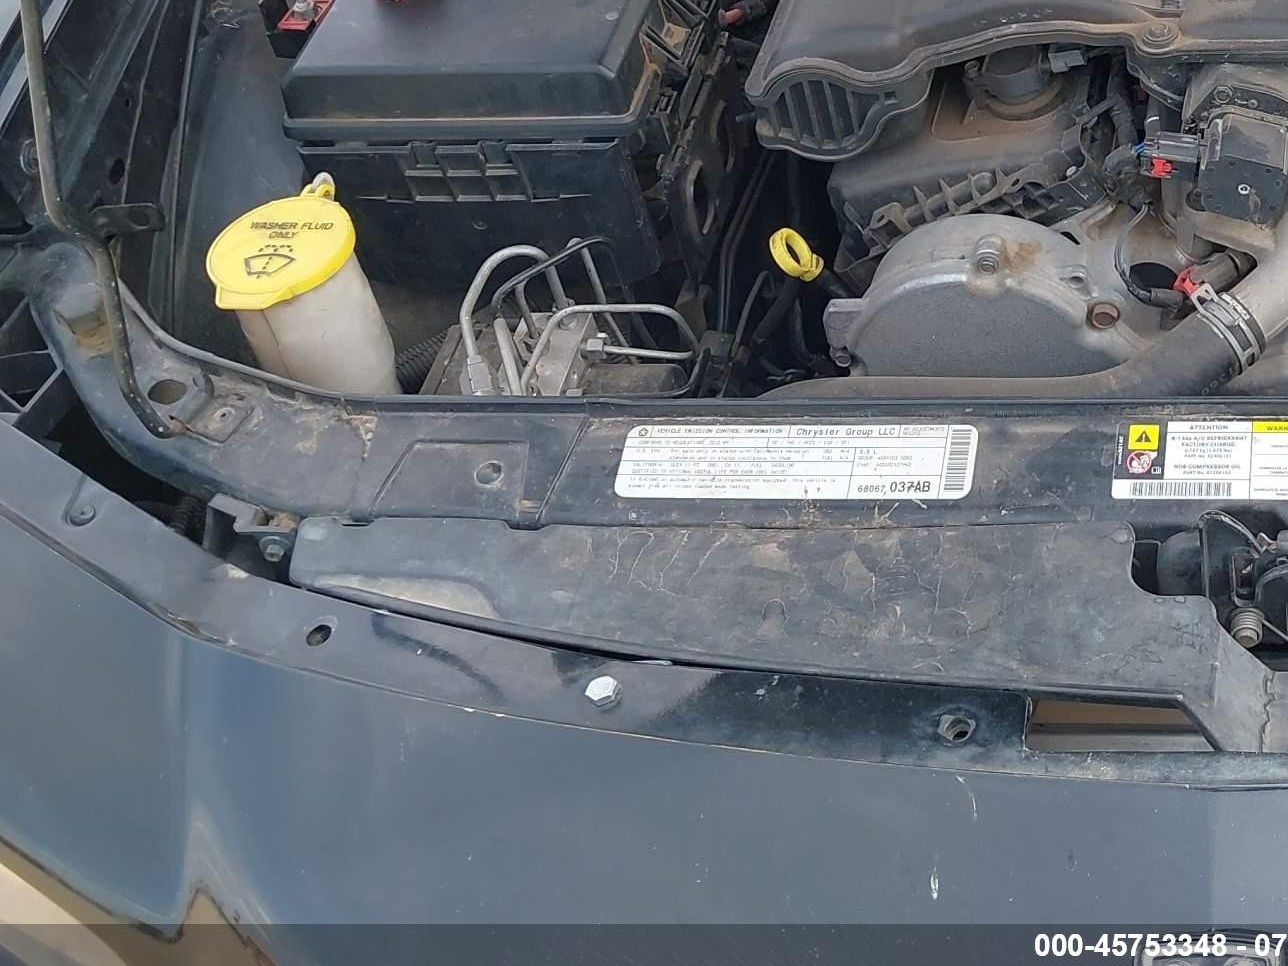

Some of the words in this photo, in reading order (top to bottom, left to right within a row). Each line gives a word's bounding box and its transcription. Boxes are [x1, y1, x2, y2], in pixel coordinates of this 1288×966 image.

[250, 221, 298, 230] WASHER
[300, 221, 334, 230] FLUID
[268, 231, 299, 239] ONLY
[796, 428, 840, 439] Chrysler
[845, 428, 873, 438] Group
[878, 428, 896, 436] LLC
[857, 484, 885, 494] 68067
[889, 480, 932, 493] 037AB
